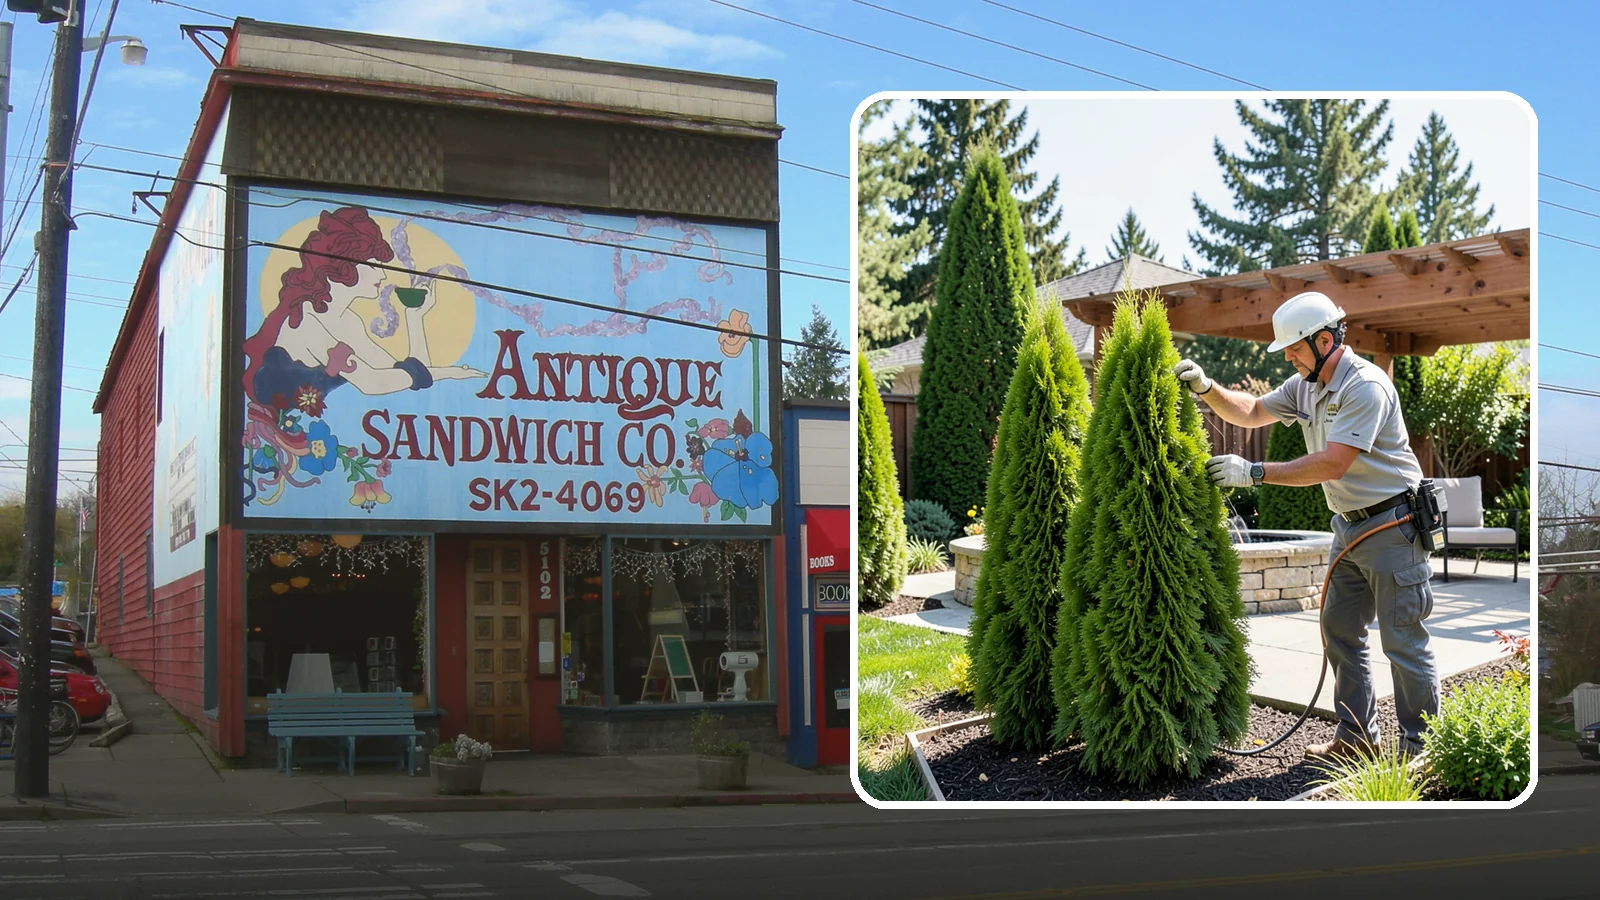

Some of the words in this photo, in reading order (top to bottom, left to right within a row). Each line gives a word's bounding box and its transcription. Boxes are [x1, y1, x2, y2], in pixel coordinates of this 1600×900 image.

[475, 329, 723, 420] ANTIQUE
[361, 408, 604, 467] SANDWICH
[617, 422, 684, 468] CO.
[469, 477, 645, 513] SK2-4069
[540, 541, 552, 600] 5102
[809, 555, 835, 569] BOOKS
